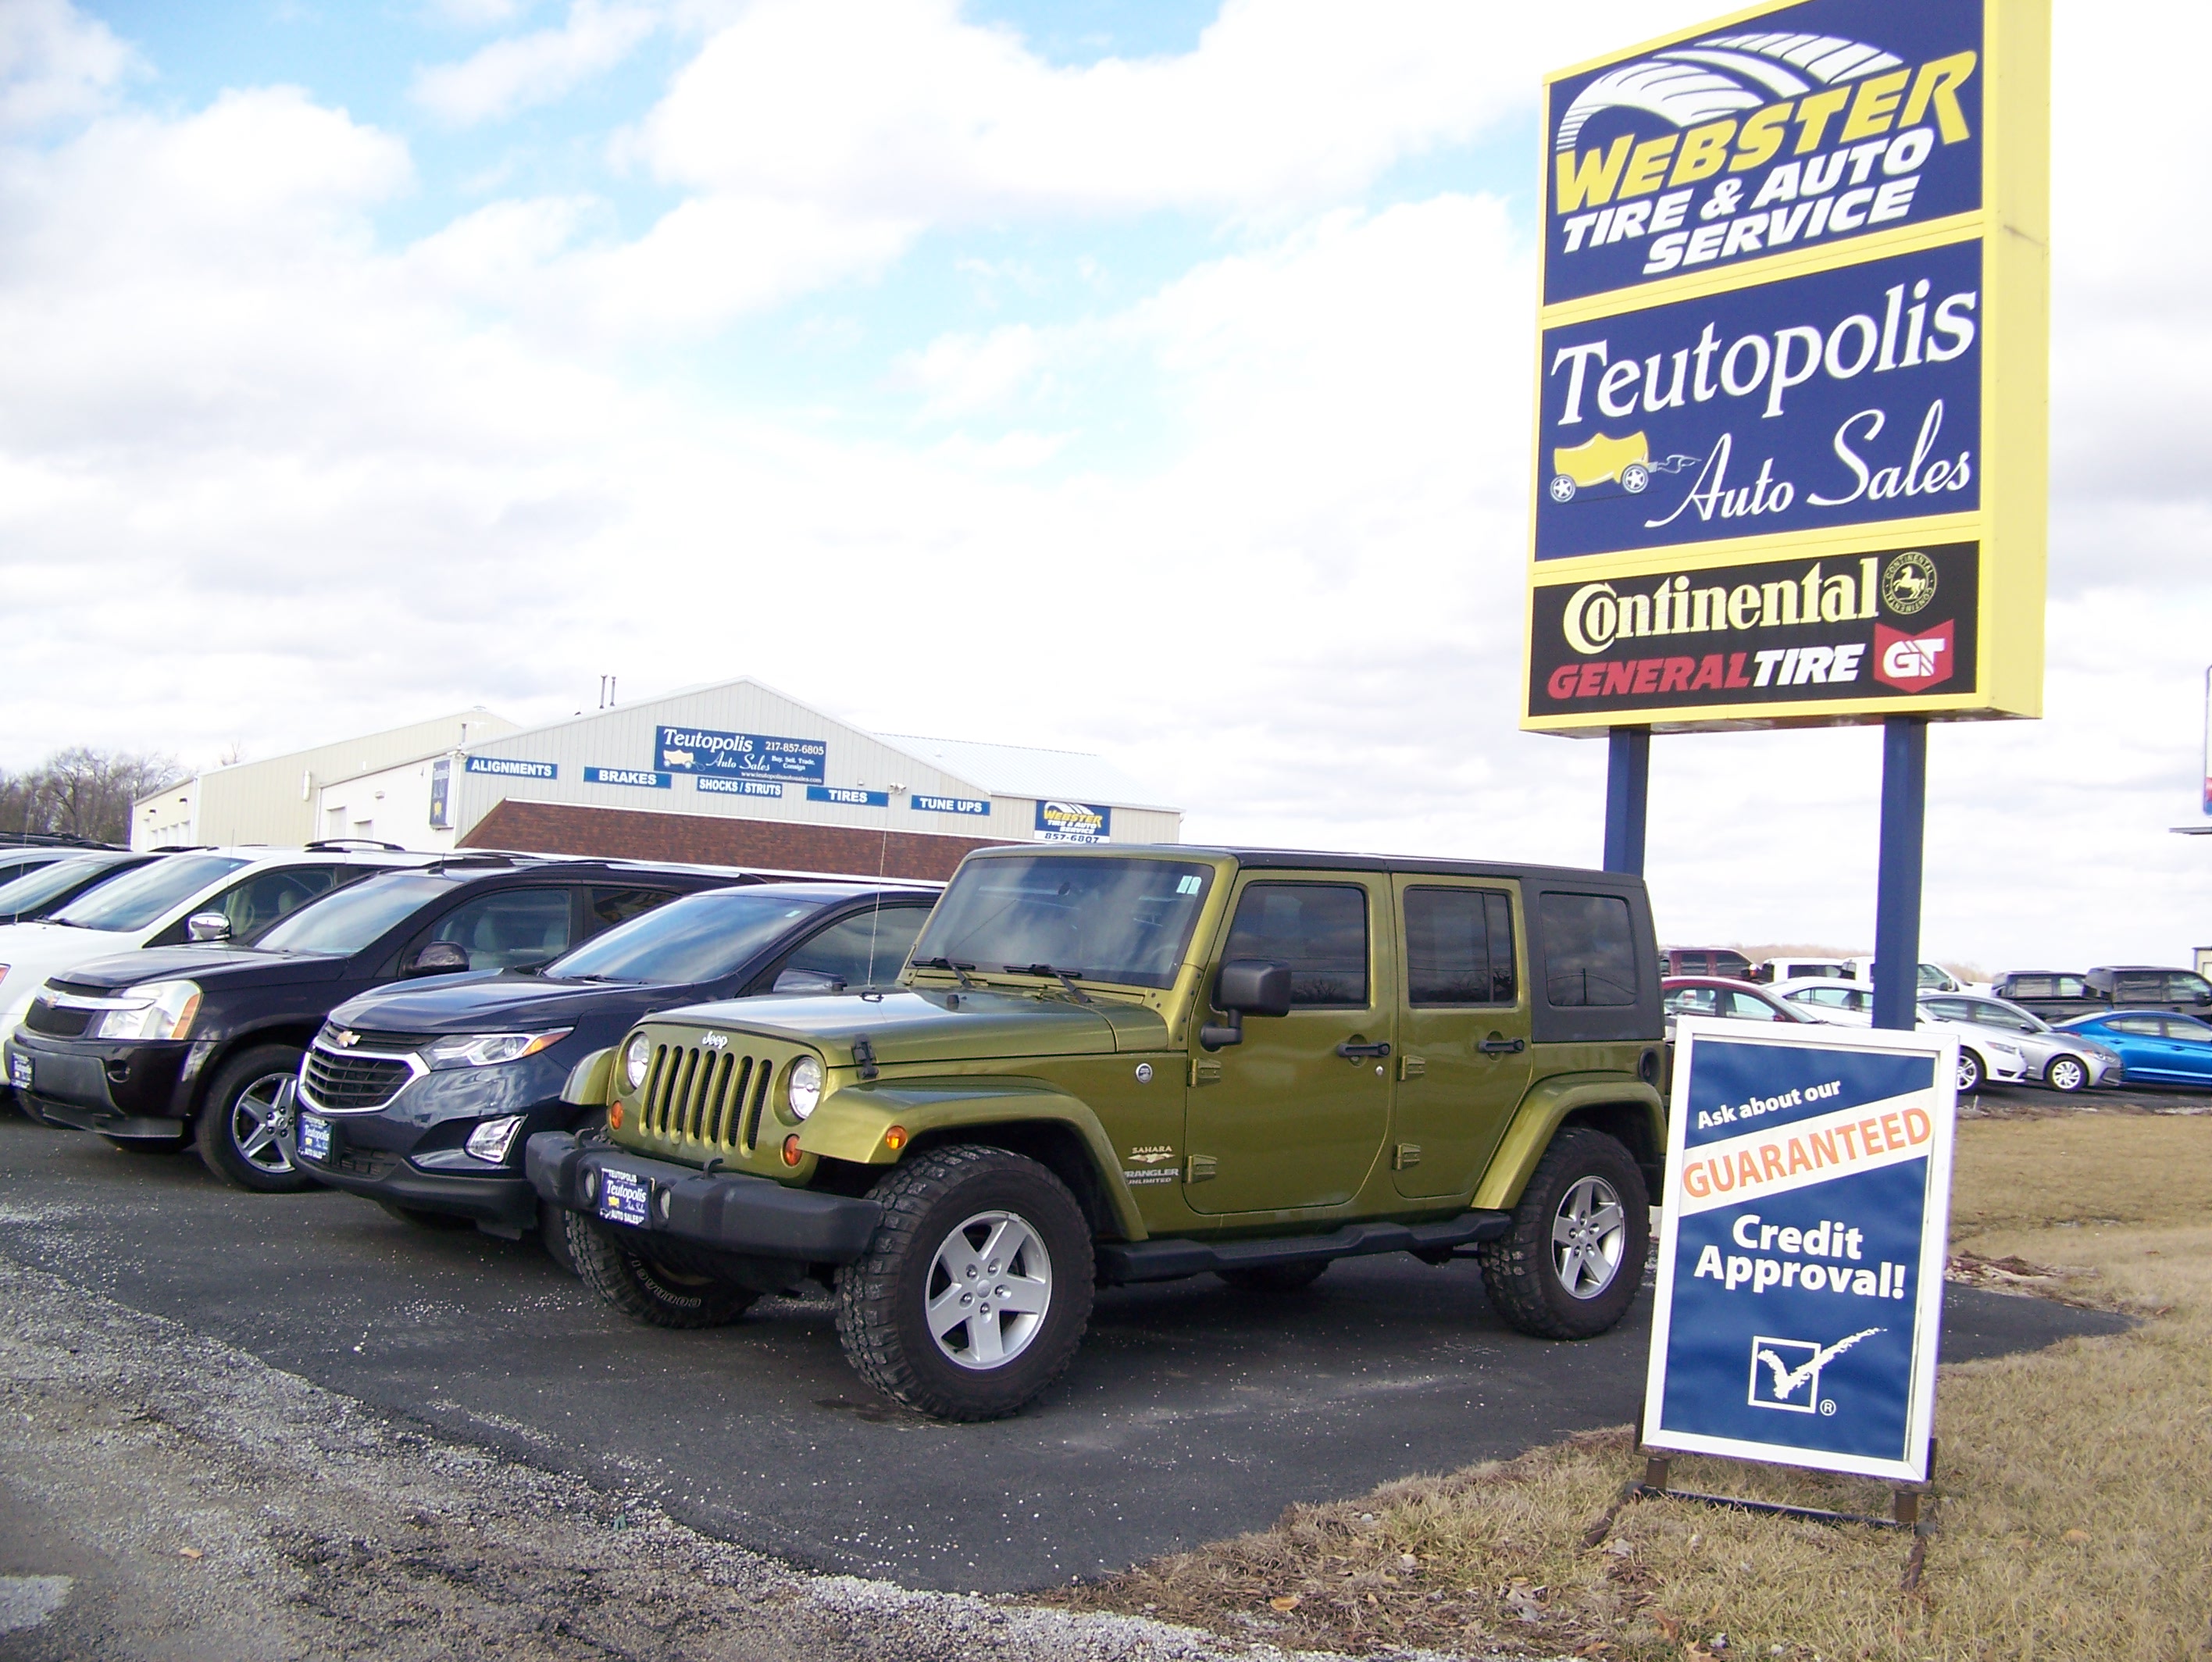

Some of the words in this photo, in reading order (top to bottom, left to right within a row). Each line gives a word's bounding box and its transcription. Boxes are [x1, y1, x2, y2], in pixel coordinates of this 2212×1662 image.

[1557, 50, 1977, 214] WEBSTER
[1563, 189, 1694, 253] TIRE
[1700, 177, 1743, 219] &
[1750, 127, 1935, 211] AUTO
[1643, 175, 1921, 275] SERVICE
[1550, 278, 1978, 426] Teutopolis
[1644, 433, 1795, 529] Auto
[1807, 399, 1971, 506] Sales
[1563, 556, 1879, 654] Continental
[1883, 637, 1946, 678] GT
[1547, 652, 1751, 701] GENERAL
[1752, 642, 1867, 687] TIRE
[664, 729, 753, 753] Teutopolis
[765, 740, 825, 756] 217-857-6805
[471, 760, 552, 777] ALIGNMENTS
[706, 751, 737, 769] Auto
[739, 753, 770, 772] Sales
[598, 769, 657, 786] BRAKES
[699, 779, 738, 793] SHOCKS
[745, 783, 781, 796] STRUTS
[828, 789, 869, 803] TIRES
[919, 797, 954, 811] TUNE
[957, 800, 983, 813] UPS
[1044, 809, 1103, 829] WEBSTER
[1059, 826, 1095, 835] SERVICE
[1044, 833, 1100, 843] 857-6807
[702, 1030, 728, 1050] Jeep
[1698, 1105, 1737, 1129] Ask
[1739, 1091, 1802, 1119] about
[1804, 1080, 1841, 1103] our
[1132, 1145, 1172, 1154] SAHARA
[1682, 1107, 1932, 1198] GUARANTEED
[606, 1179, 647, 1203] Teutopolis
[1732, 1214, 1864, 1261] Credit
[1693, 1244, 1907, 1300] Approval!
